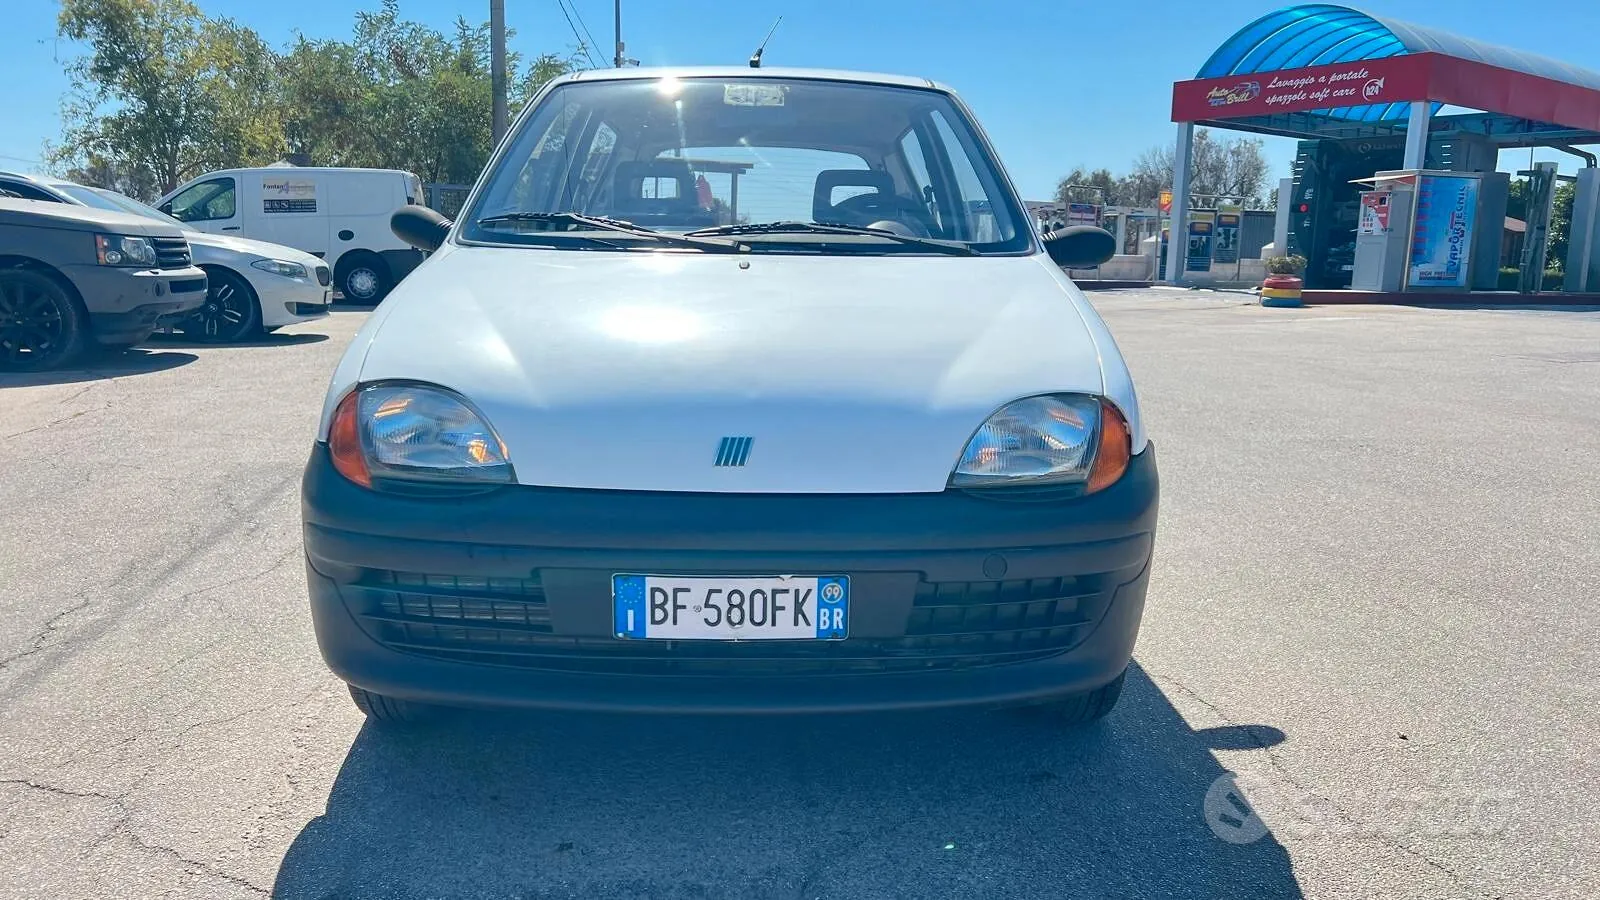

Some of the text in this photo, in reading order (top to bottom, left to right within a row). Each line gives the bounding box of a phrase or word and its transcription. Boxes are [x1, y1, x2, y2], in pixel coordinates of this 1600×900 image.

[1267, 76, 1315, 89] Lavaggio
[1328, 68, 1369, 84] portale
[1206, 86, 1230, 98] Auto
[1265, 87, 1356, 105] spazzole soft care
[825, 587, 840, 598] 99
[627, 587, 813, 632] I BF 580FK
[819, 608, 844, 629] BR
